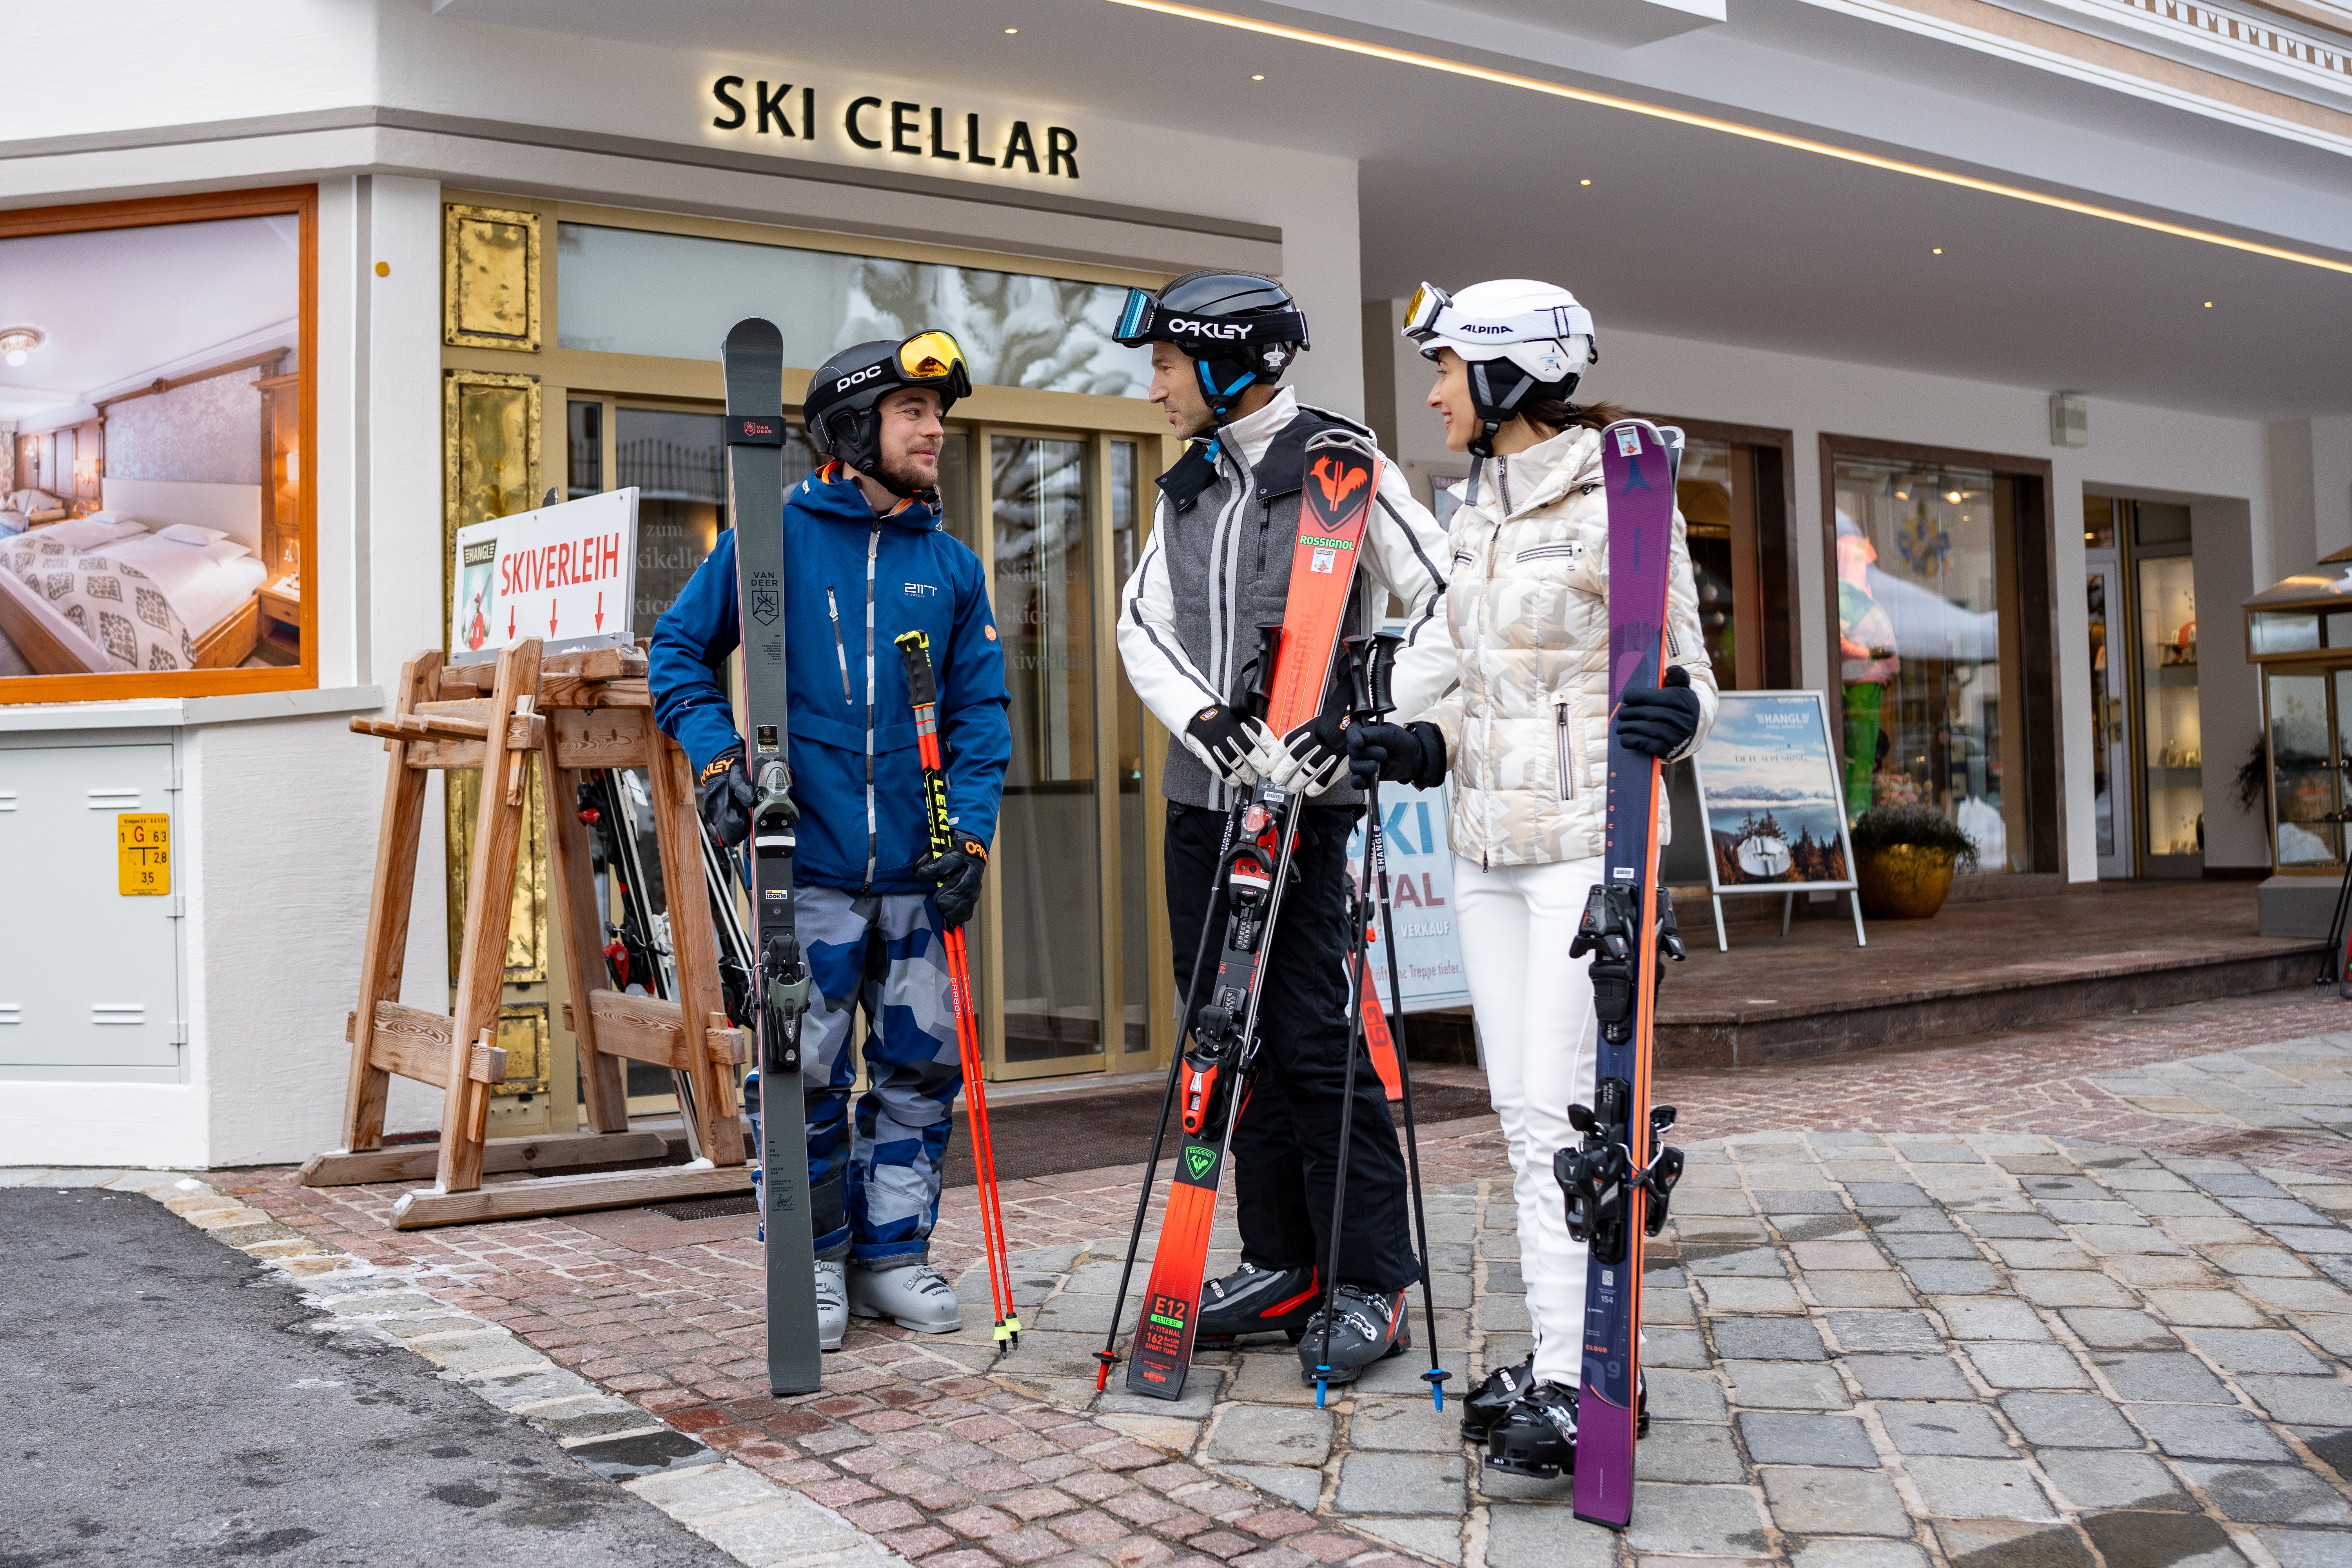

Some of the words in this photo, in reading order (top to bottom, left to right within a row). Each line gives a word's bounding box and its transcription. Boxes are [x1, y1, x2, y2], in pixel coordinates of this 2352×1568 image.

[713, 75, 815, 140] SKI
[845, 96, 1080, 178] CELLAR
[1147, 310, 1155, 330] OAKLEY
[1169, 318, 1253, 339] OAKLEY
[1459, 324, 1514, 334] ALPINA
[837, 365, 882, 392] POC
[646, 524, 683, 537] zum
[1299, 535, 1355, 551] ROSSIGNOL
[469, 544, 491, 563] HANGL
[501, 532, 619, 597] SKIVERLEIH
[1764, 713, 1802, 724] HANGL
[933, 779, 949, 831] LEKI
[134, 826, 144, 842] G
[1374, 832, 1385, 865] HANGL
[1401, 921, 1450, 938] VERKAUF
[1408, 964, 1436, 980] Treppe
[951, 977, 961, 1019] CARBON
[1189, 1149, 1212, 1159] ROSSIGNOL
[1154, 1296, 1186, 1319] E12
[1601, 1295, 1614, 1304] 154
[1156, 1316, 1171, 1325] ELITE
[1147, 1332, 1163, 1345] 162
[1163, 1336, 1180, 1345] R=12M
[1149, 1324, 1181, 1338] V-TITANAL
[1145, 1342, 1162, 1352] SHORT
[1163, 1347, 1177, 1356] TURN
[1585, 1344, 1608, 1353] CLOUD
